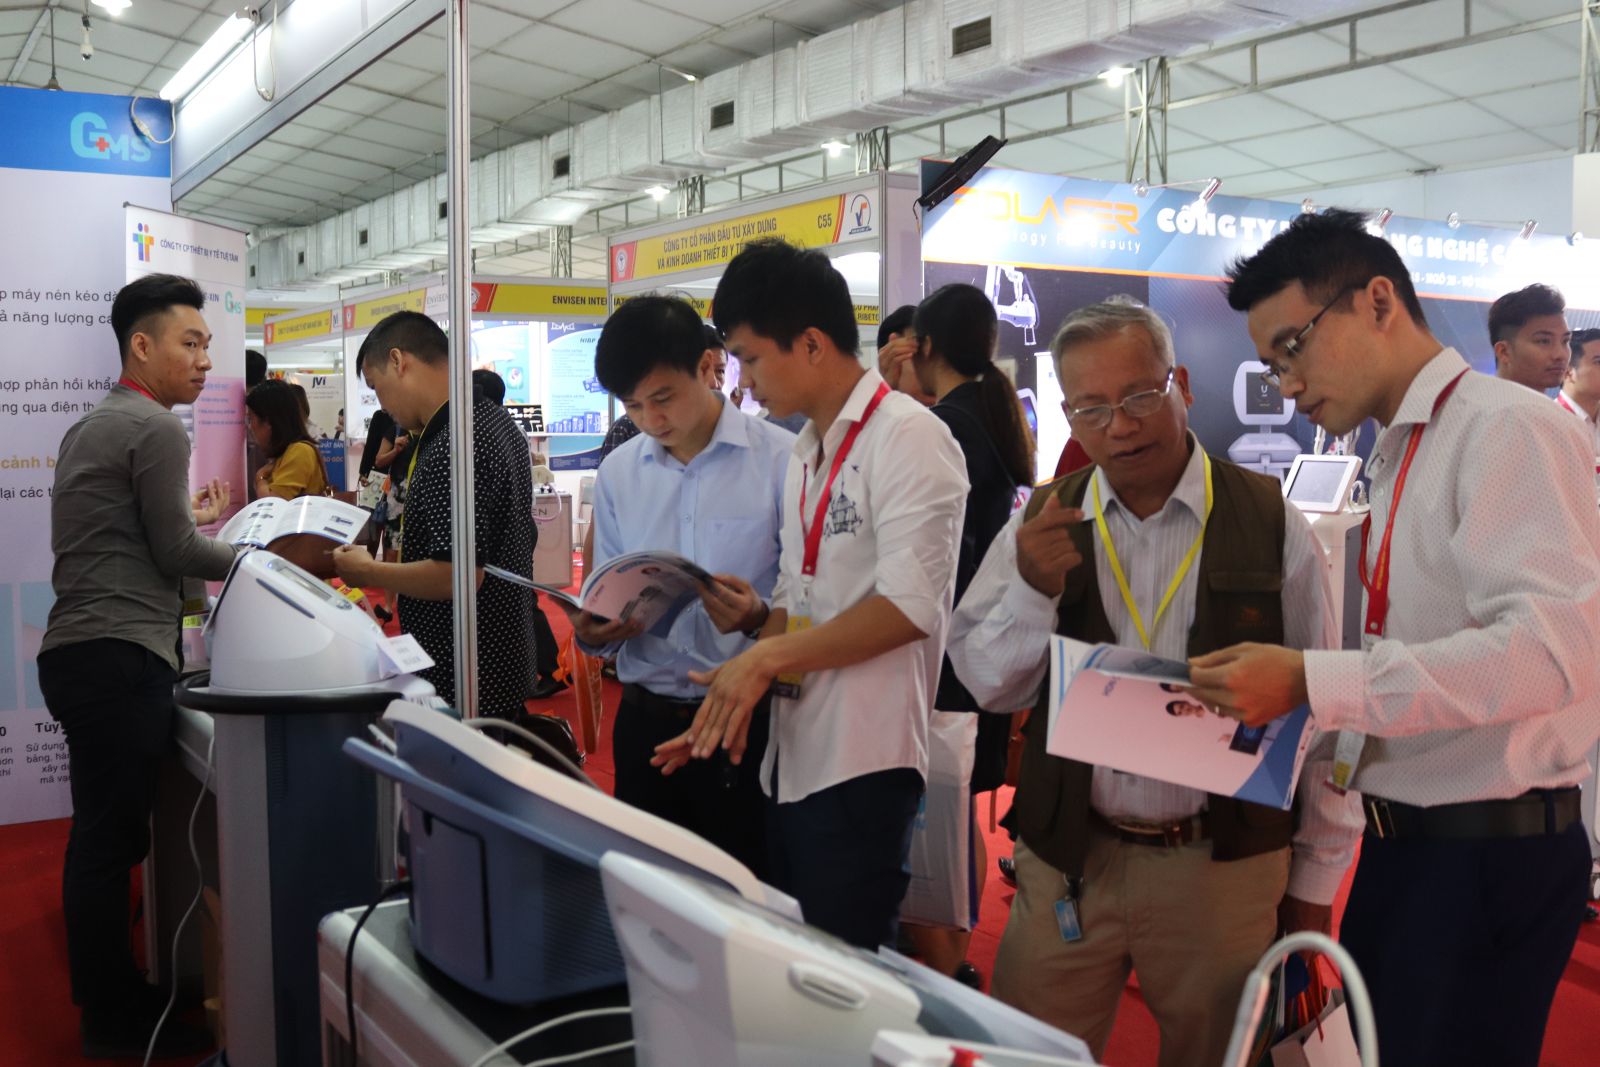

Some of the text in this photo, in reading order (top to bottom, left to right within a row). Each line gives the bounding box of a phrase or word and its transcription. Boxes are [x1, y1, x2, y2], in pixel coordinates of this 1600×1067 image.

[681, 236, 688, 249] TY
[817, 212, 833, 230] C55
[665, 254, 680, 269] KINH
[681, 250, 702, 266] DOANH
[730, 243, 735, 255] Y
[12, 288, 41, 303] máy
[45, 288, 71, 301] nén
[75, 289, 100, 302] kéo
[552, 295, 586, 305] ENVISEN
[13, 311, 49, 326] năng
[54, 311, 94, 327] lượng
[25, 377, 58, 392] phản
[63, 377, 83, 391] hồi
[22, 403, 47, 415] qua
[51, 401, 79, 415] điện
[0, 454, 40, 469] cảnh
[20, 486, 44, 498] các
